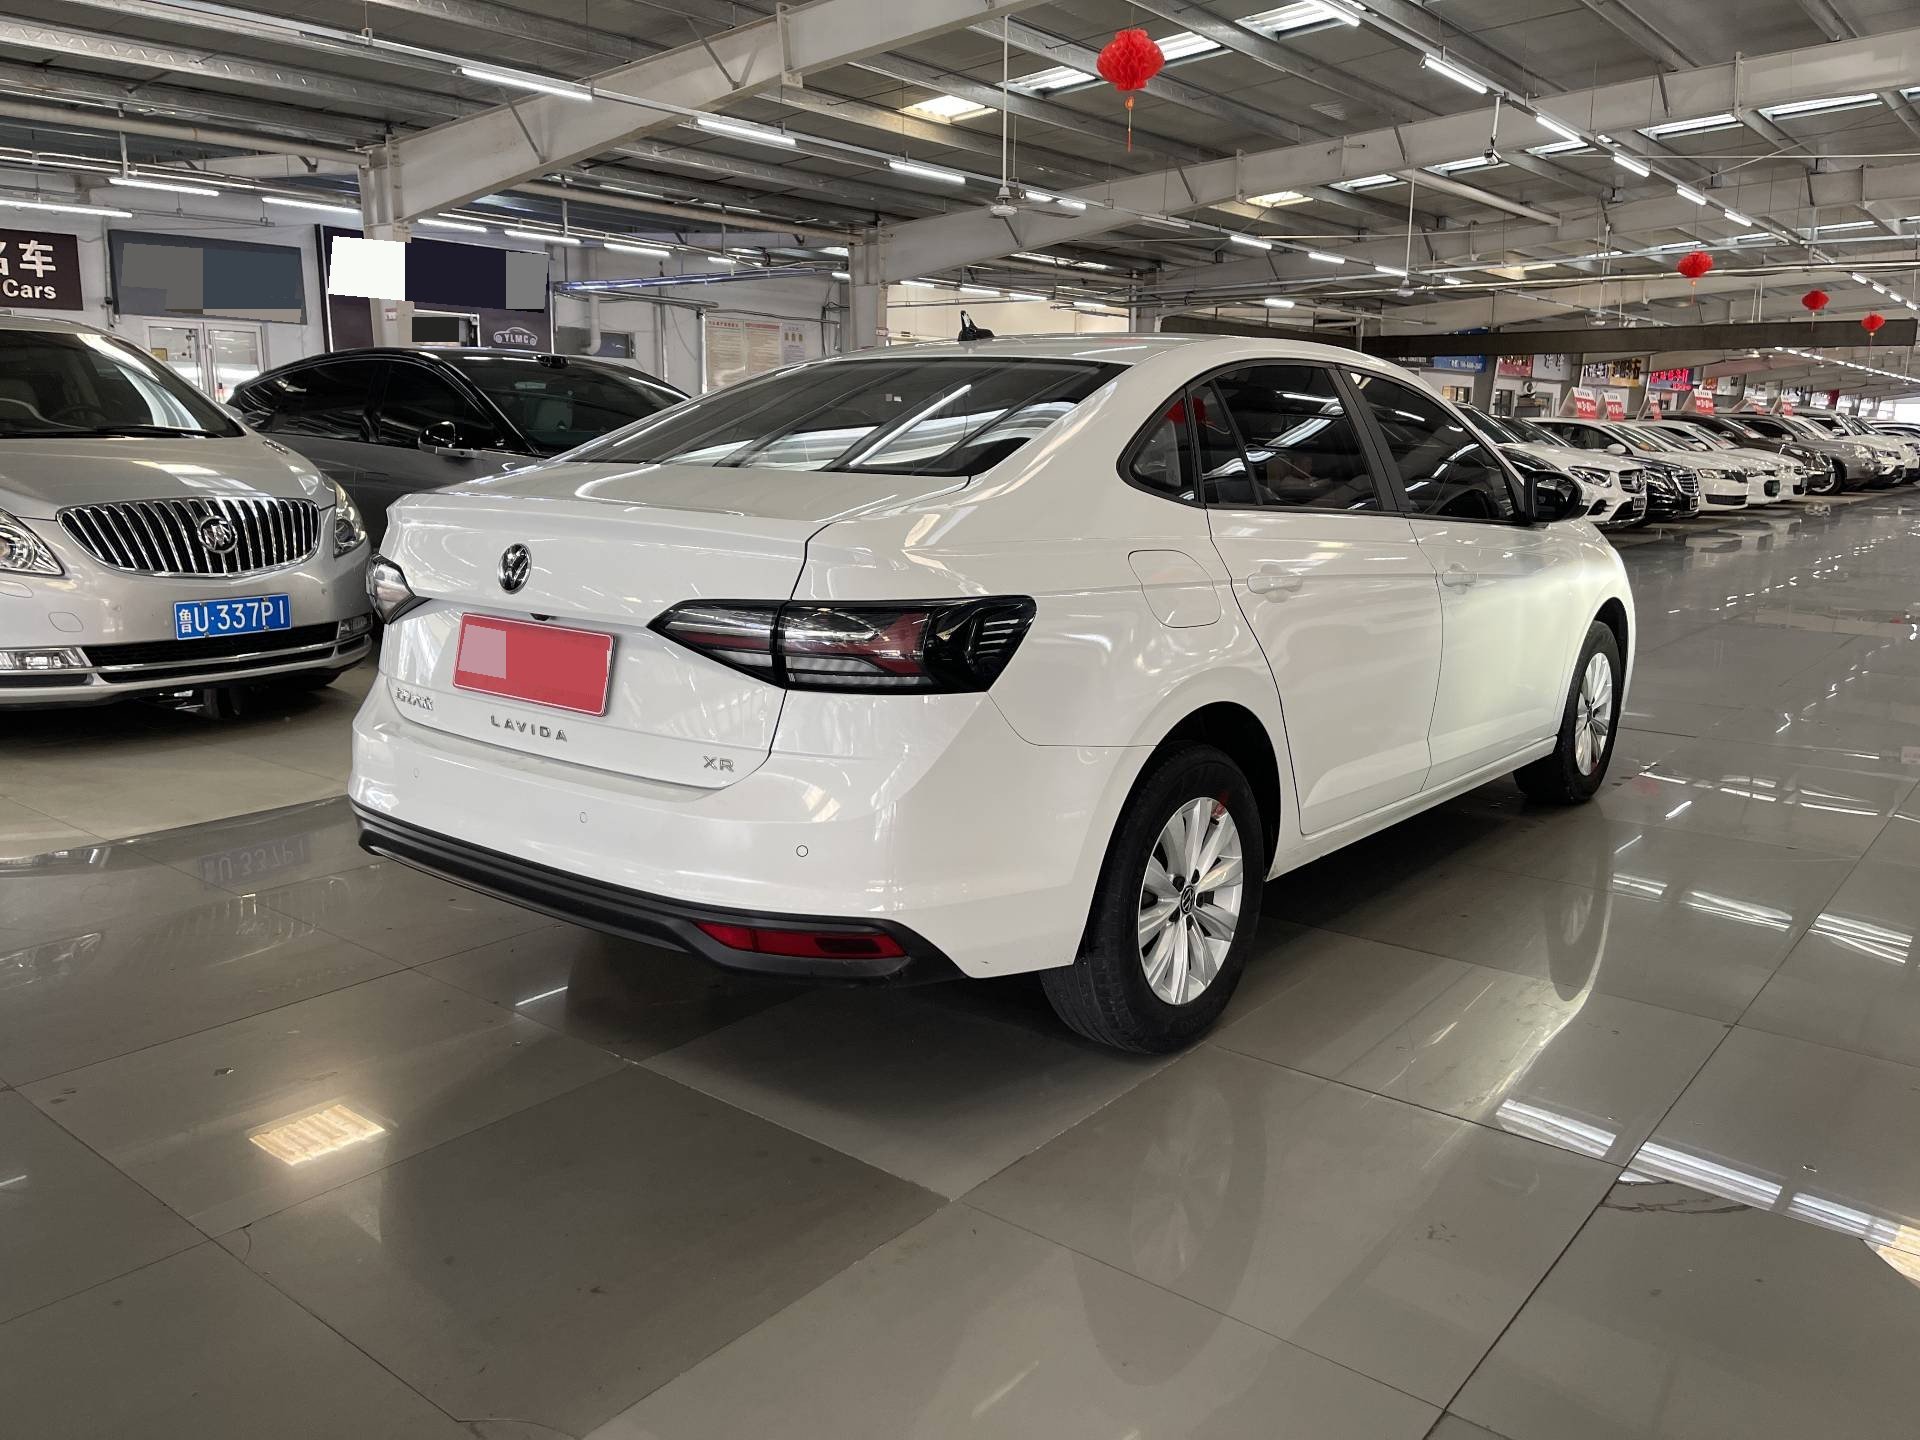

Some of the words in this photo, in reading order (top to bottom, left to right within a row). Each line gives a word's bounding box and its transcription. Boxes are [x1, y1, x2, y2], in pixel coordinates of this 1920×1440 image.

[0, 239, 56, 278] 车
[2, 279, 57, 299] Cars
[490, 714, 568, 743] LAVIDA
[703, 755, 734, 772] XR
